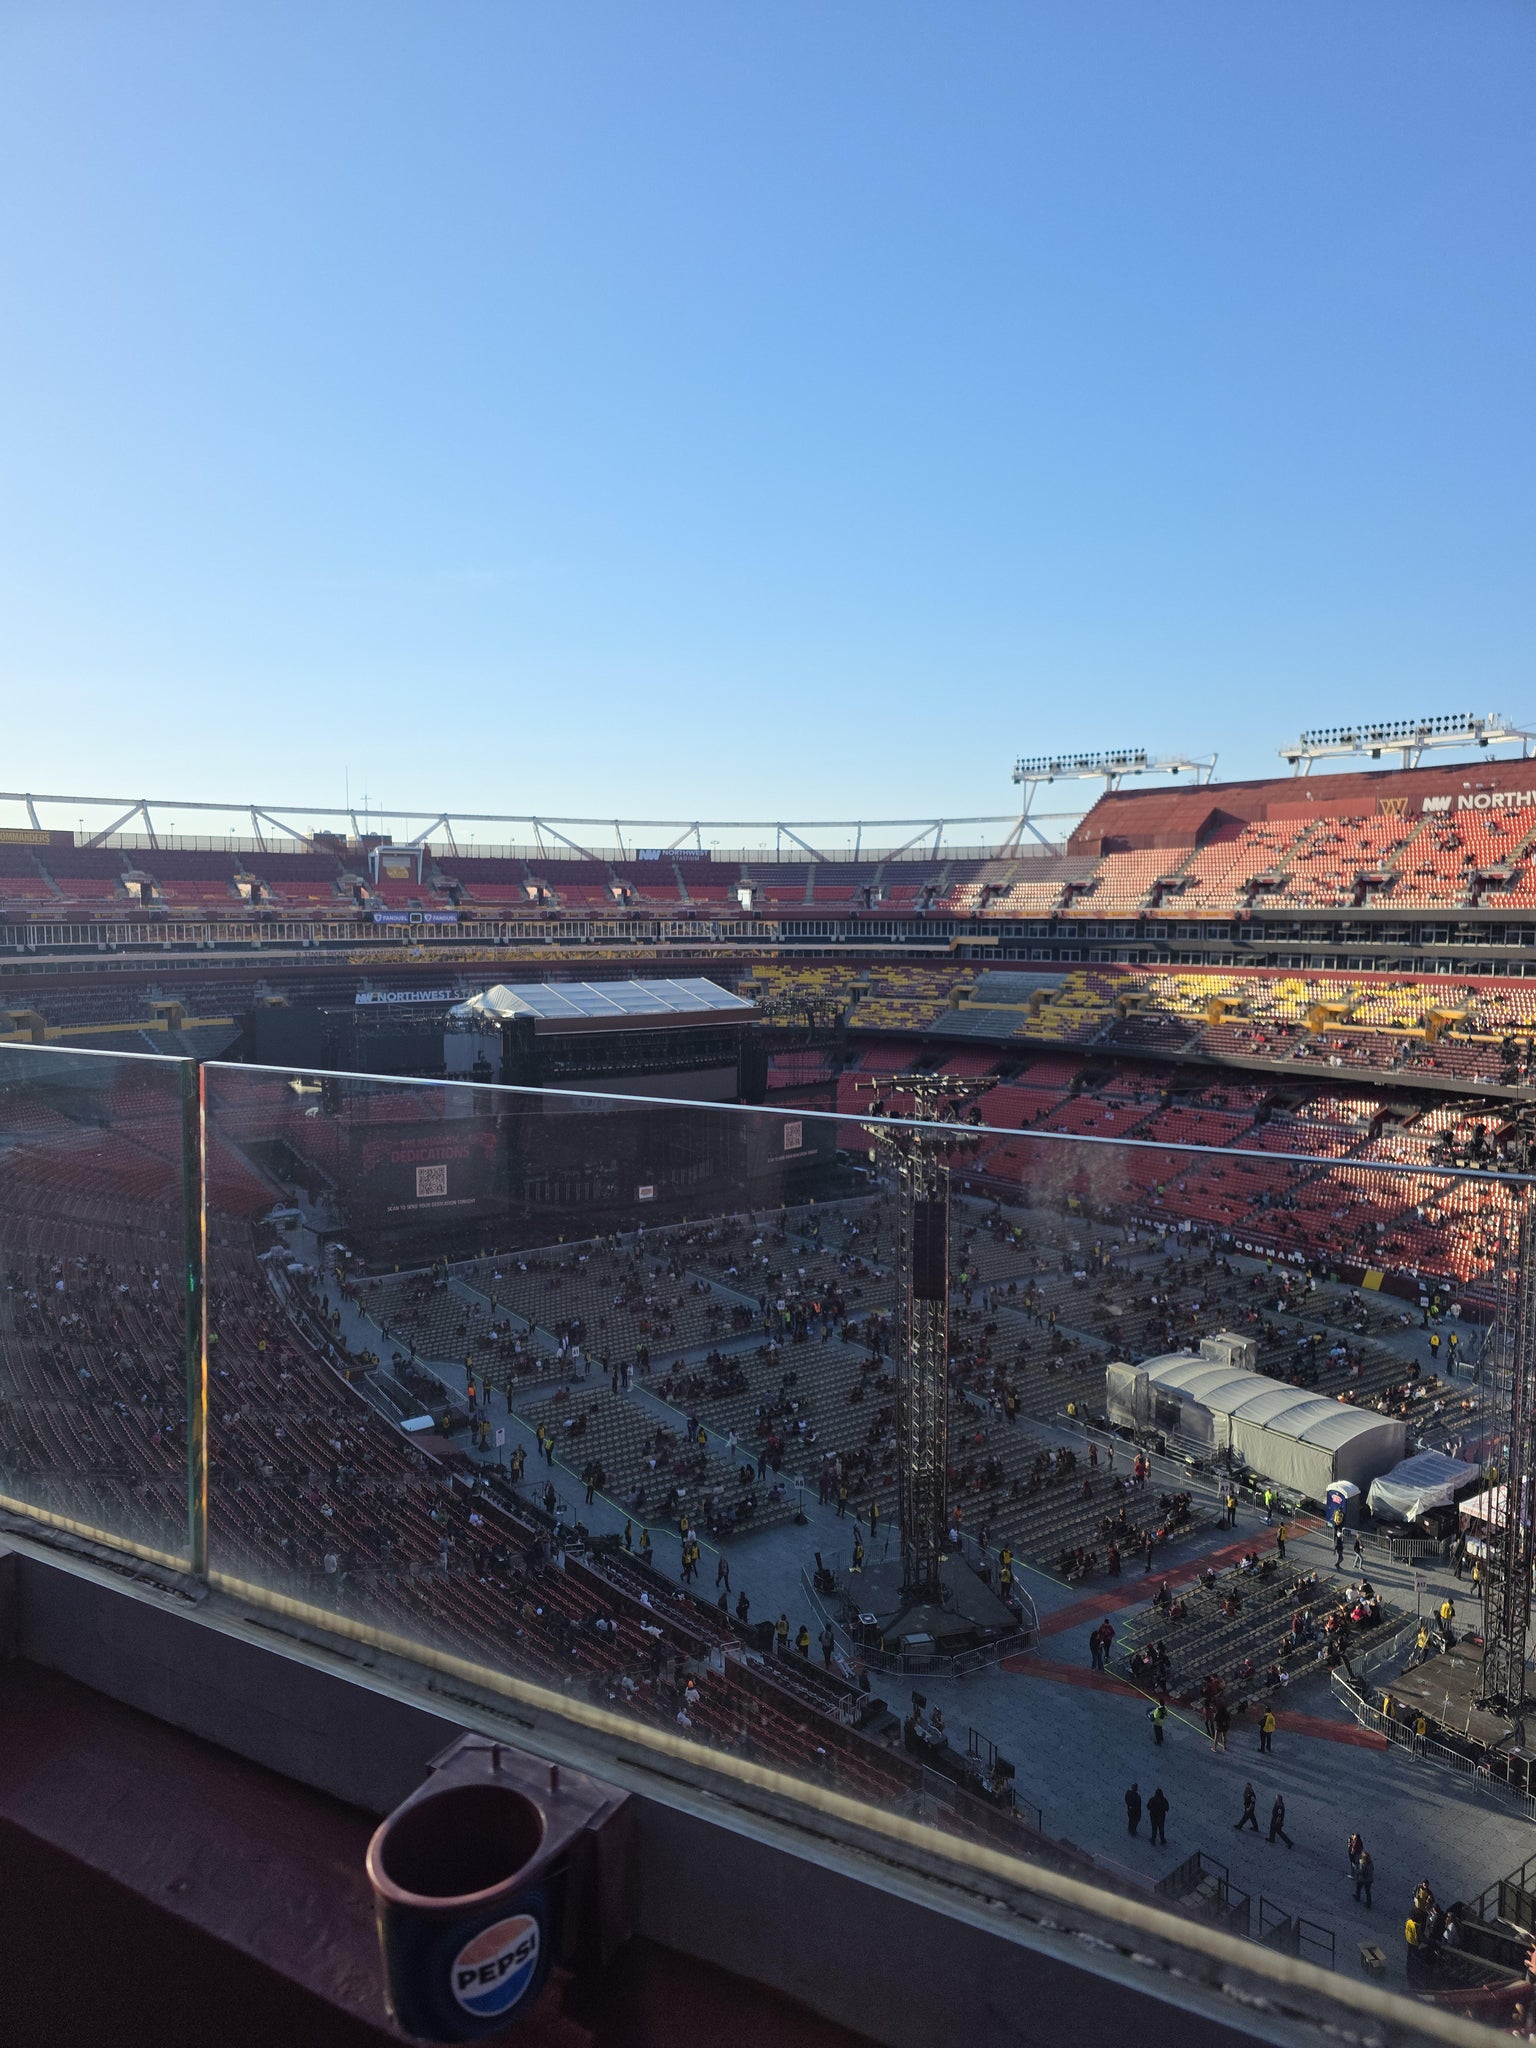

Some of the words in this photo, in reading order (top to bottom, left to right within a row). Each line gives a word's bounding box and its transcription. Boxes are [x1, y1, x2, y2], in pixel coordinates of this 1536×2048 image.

[1422, 796, 1452, 812] NW
[1458, 789, 1536, 810] NORTH
[0, 831, 50, 843] OMMANDERS
[377, 990, 452, 1001] NORTHWEST
[392, 1146, 469, 1162] DEDICATIONS
[1235, 1241, 1305, 1264] COMMAND
[457, 1932, 535, 1990] PEPSI
